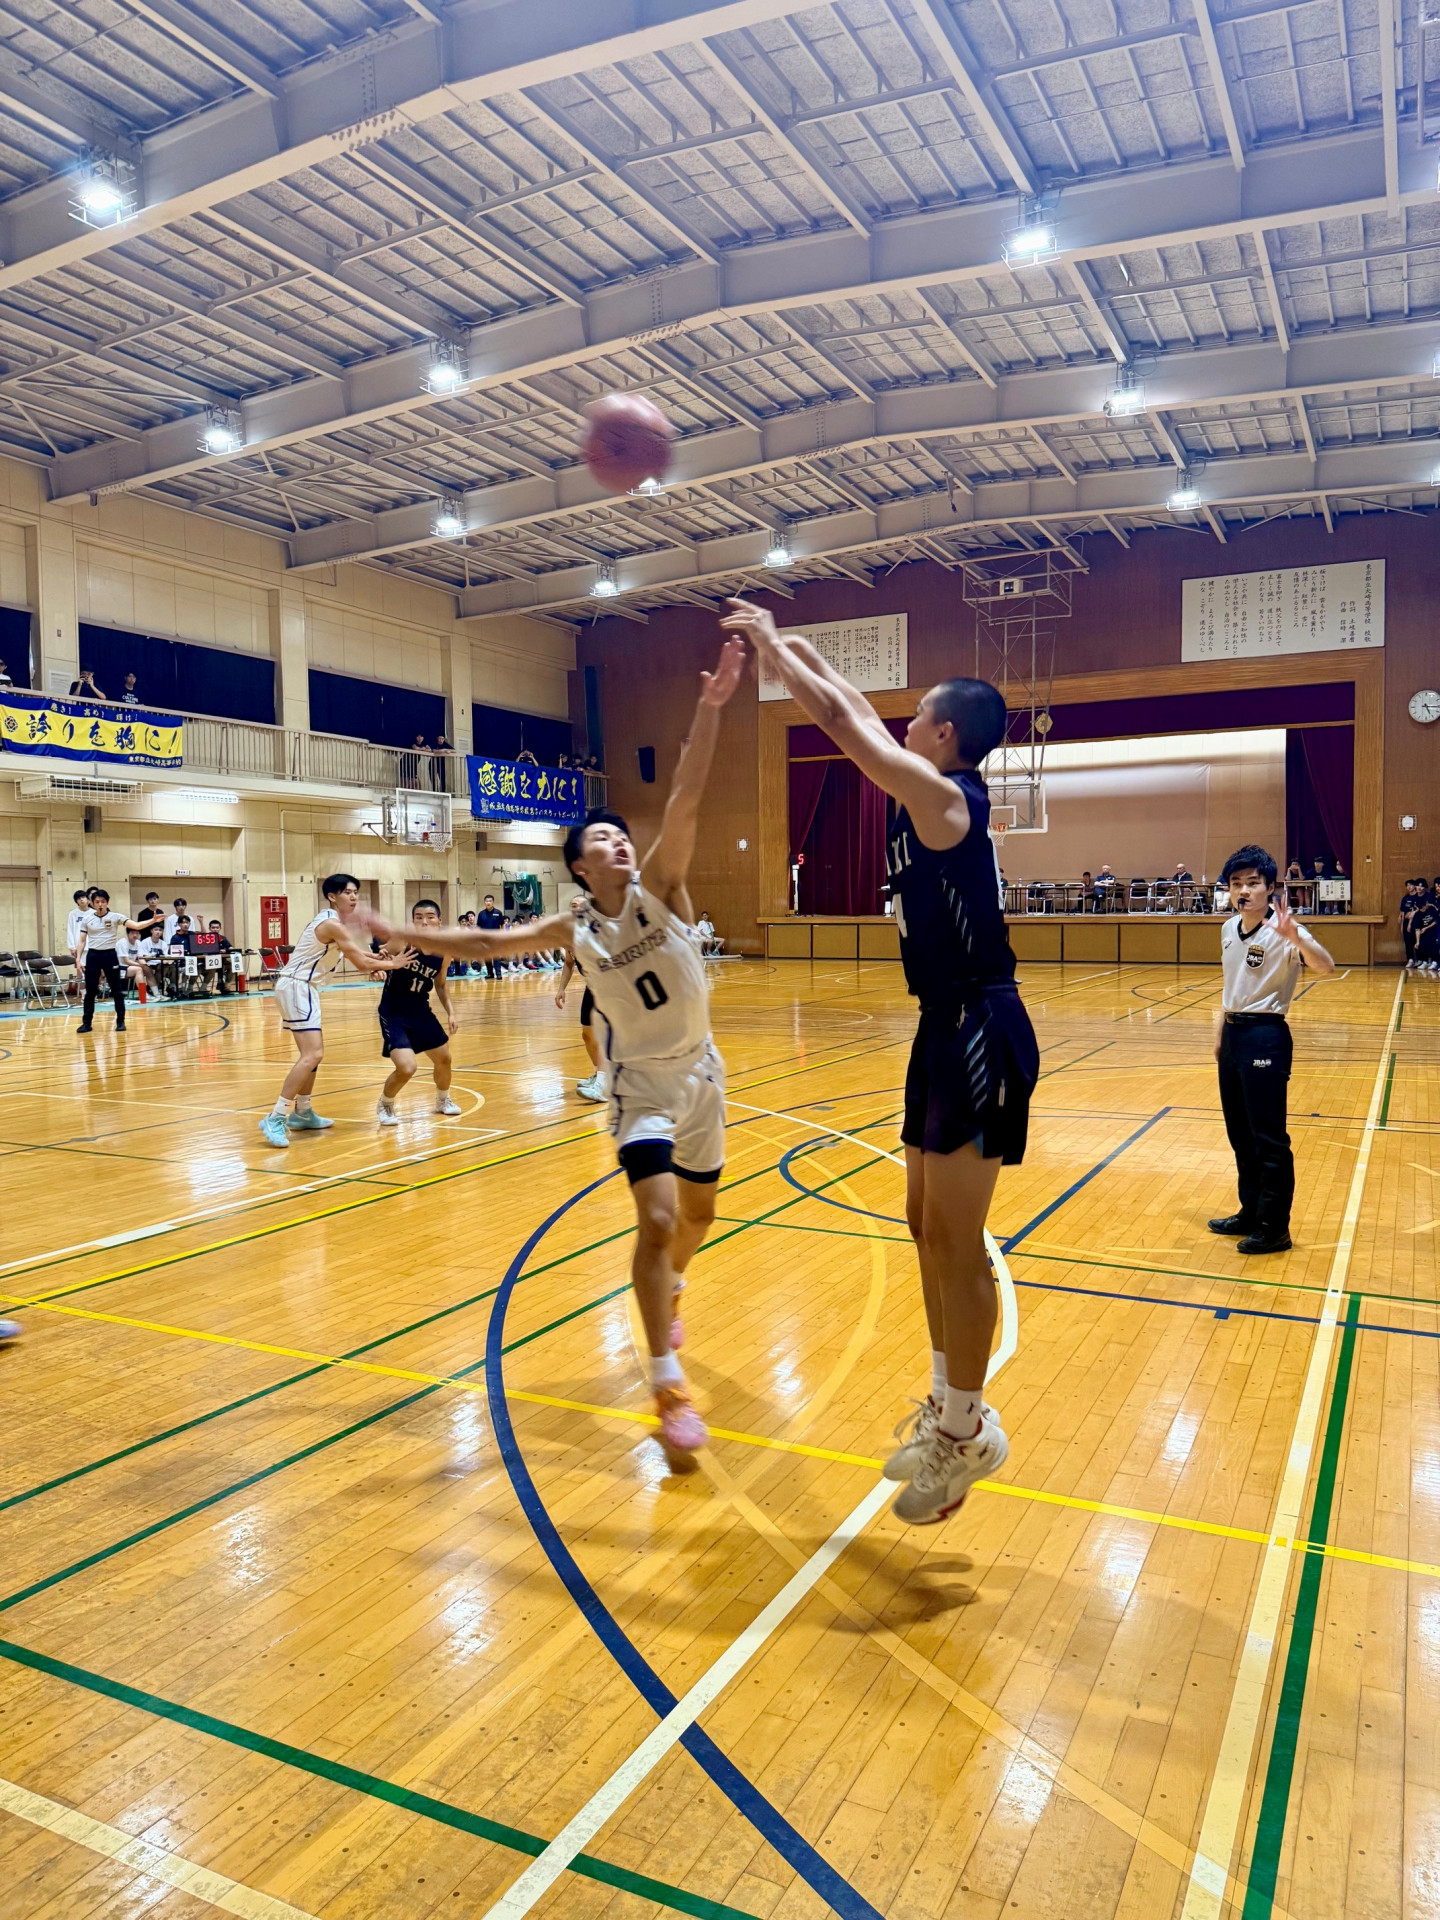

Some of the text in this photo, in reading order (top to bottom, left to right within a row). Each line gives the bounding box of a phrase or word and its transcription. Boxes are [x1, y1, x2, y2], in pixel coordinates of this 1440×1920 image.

[1364, 563, 1372, 624] 東京都立大崎高等学校
[1340, 602, 1347, 613] 作曲
[197, 934, 216, 944] 6:53
[635, 971, 668, 1010] 0
